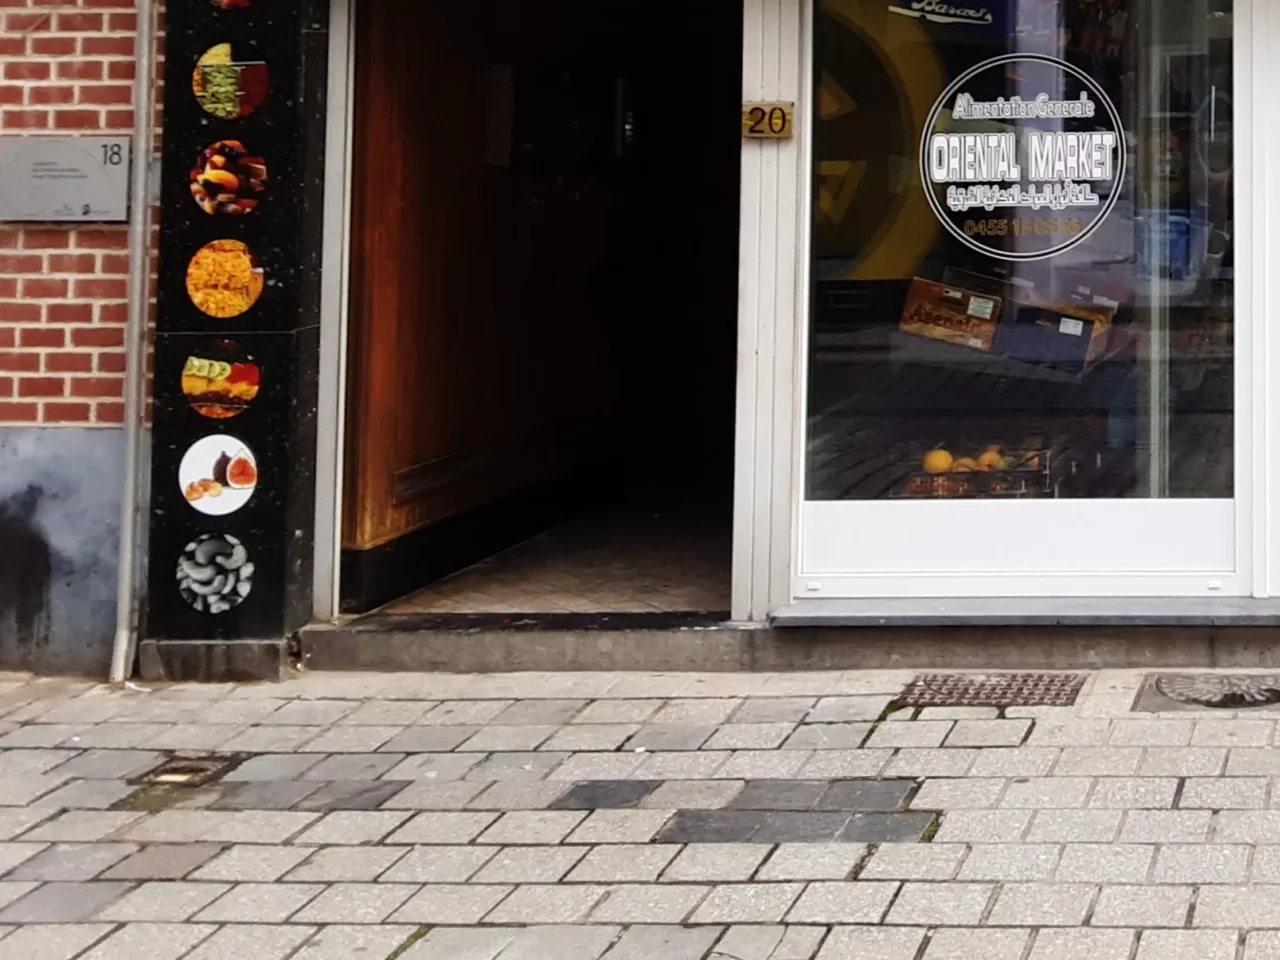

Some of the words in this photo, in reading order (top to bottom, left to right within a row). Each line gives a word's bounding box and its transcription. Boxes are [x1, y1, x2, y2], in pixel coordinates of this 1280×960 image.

[953, 93, 1036, 119] Alimentation
[1036, 91, 1095, 118] Generale
[748, 106, 786, 134] 20
[100, 143, 122, 165] 18
[931, 133, 1021, 182] ORIENTAL
[1028, 132, 1116, 180] MARKET
